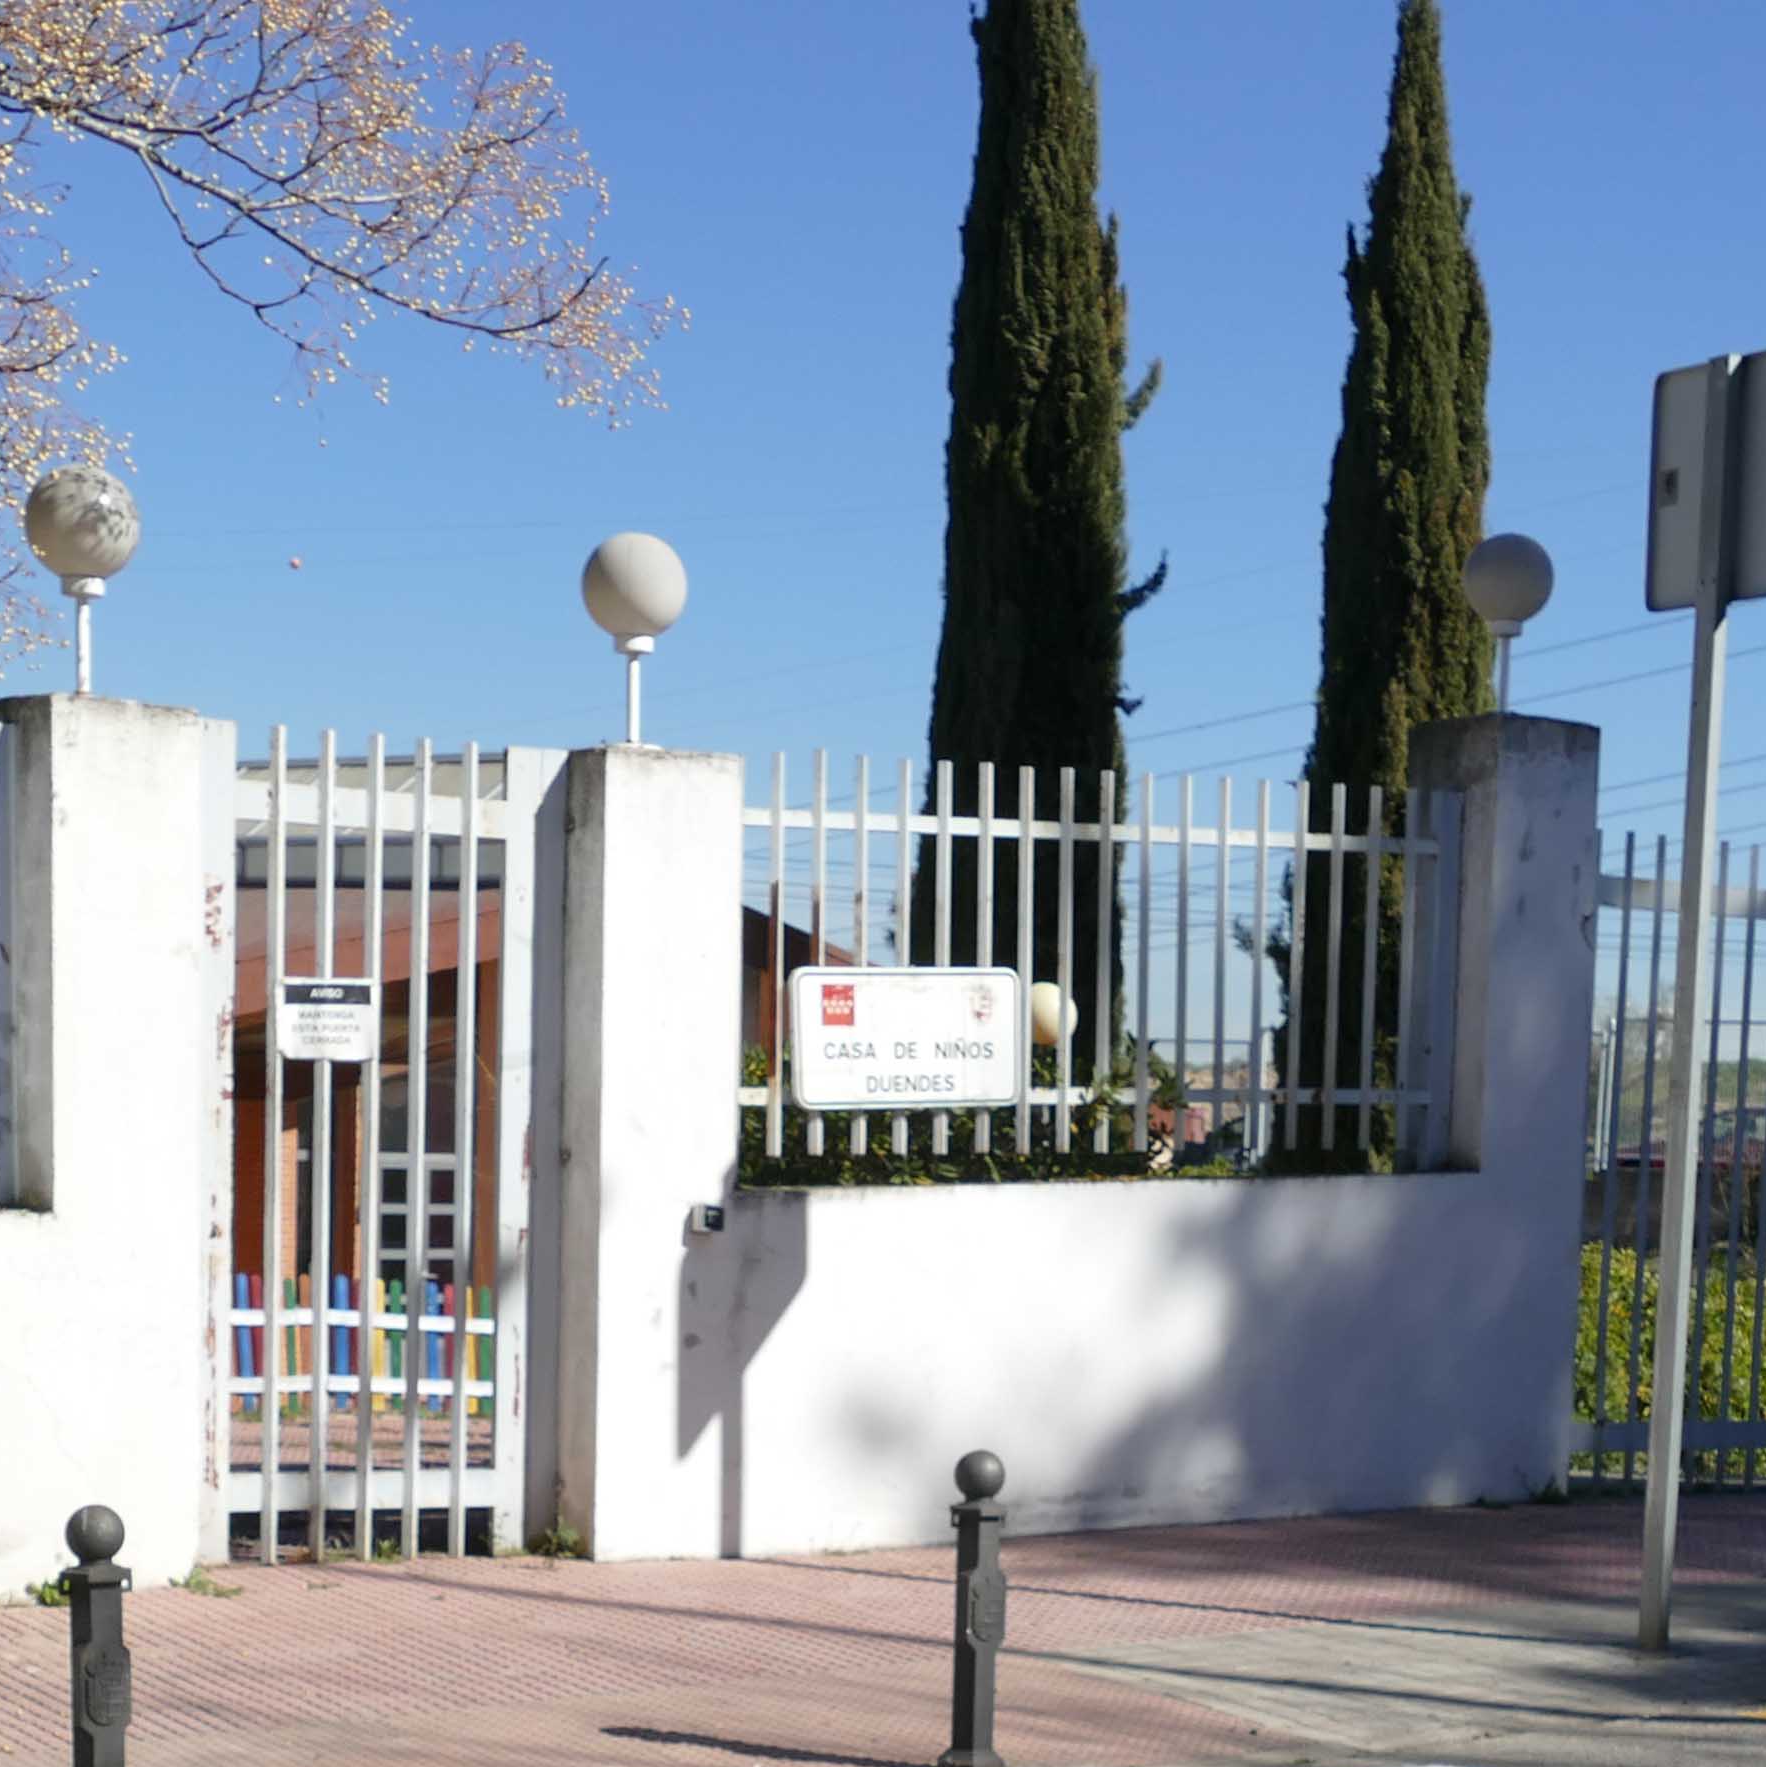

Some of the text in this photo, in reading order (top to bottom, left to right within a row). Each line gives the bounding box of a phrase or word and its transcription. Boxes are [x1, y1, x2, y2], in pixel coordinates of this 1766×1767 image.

[823, 1036, 994, 1060] CASA DE NIÑOS
[866, 1074, 955, 1094] DUENDES
